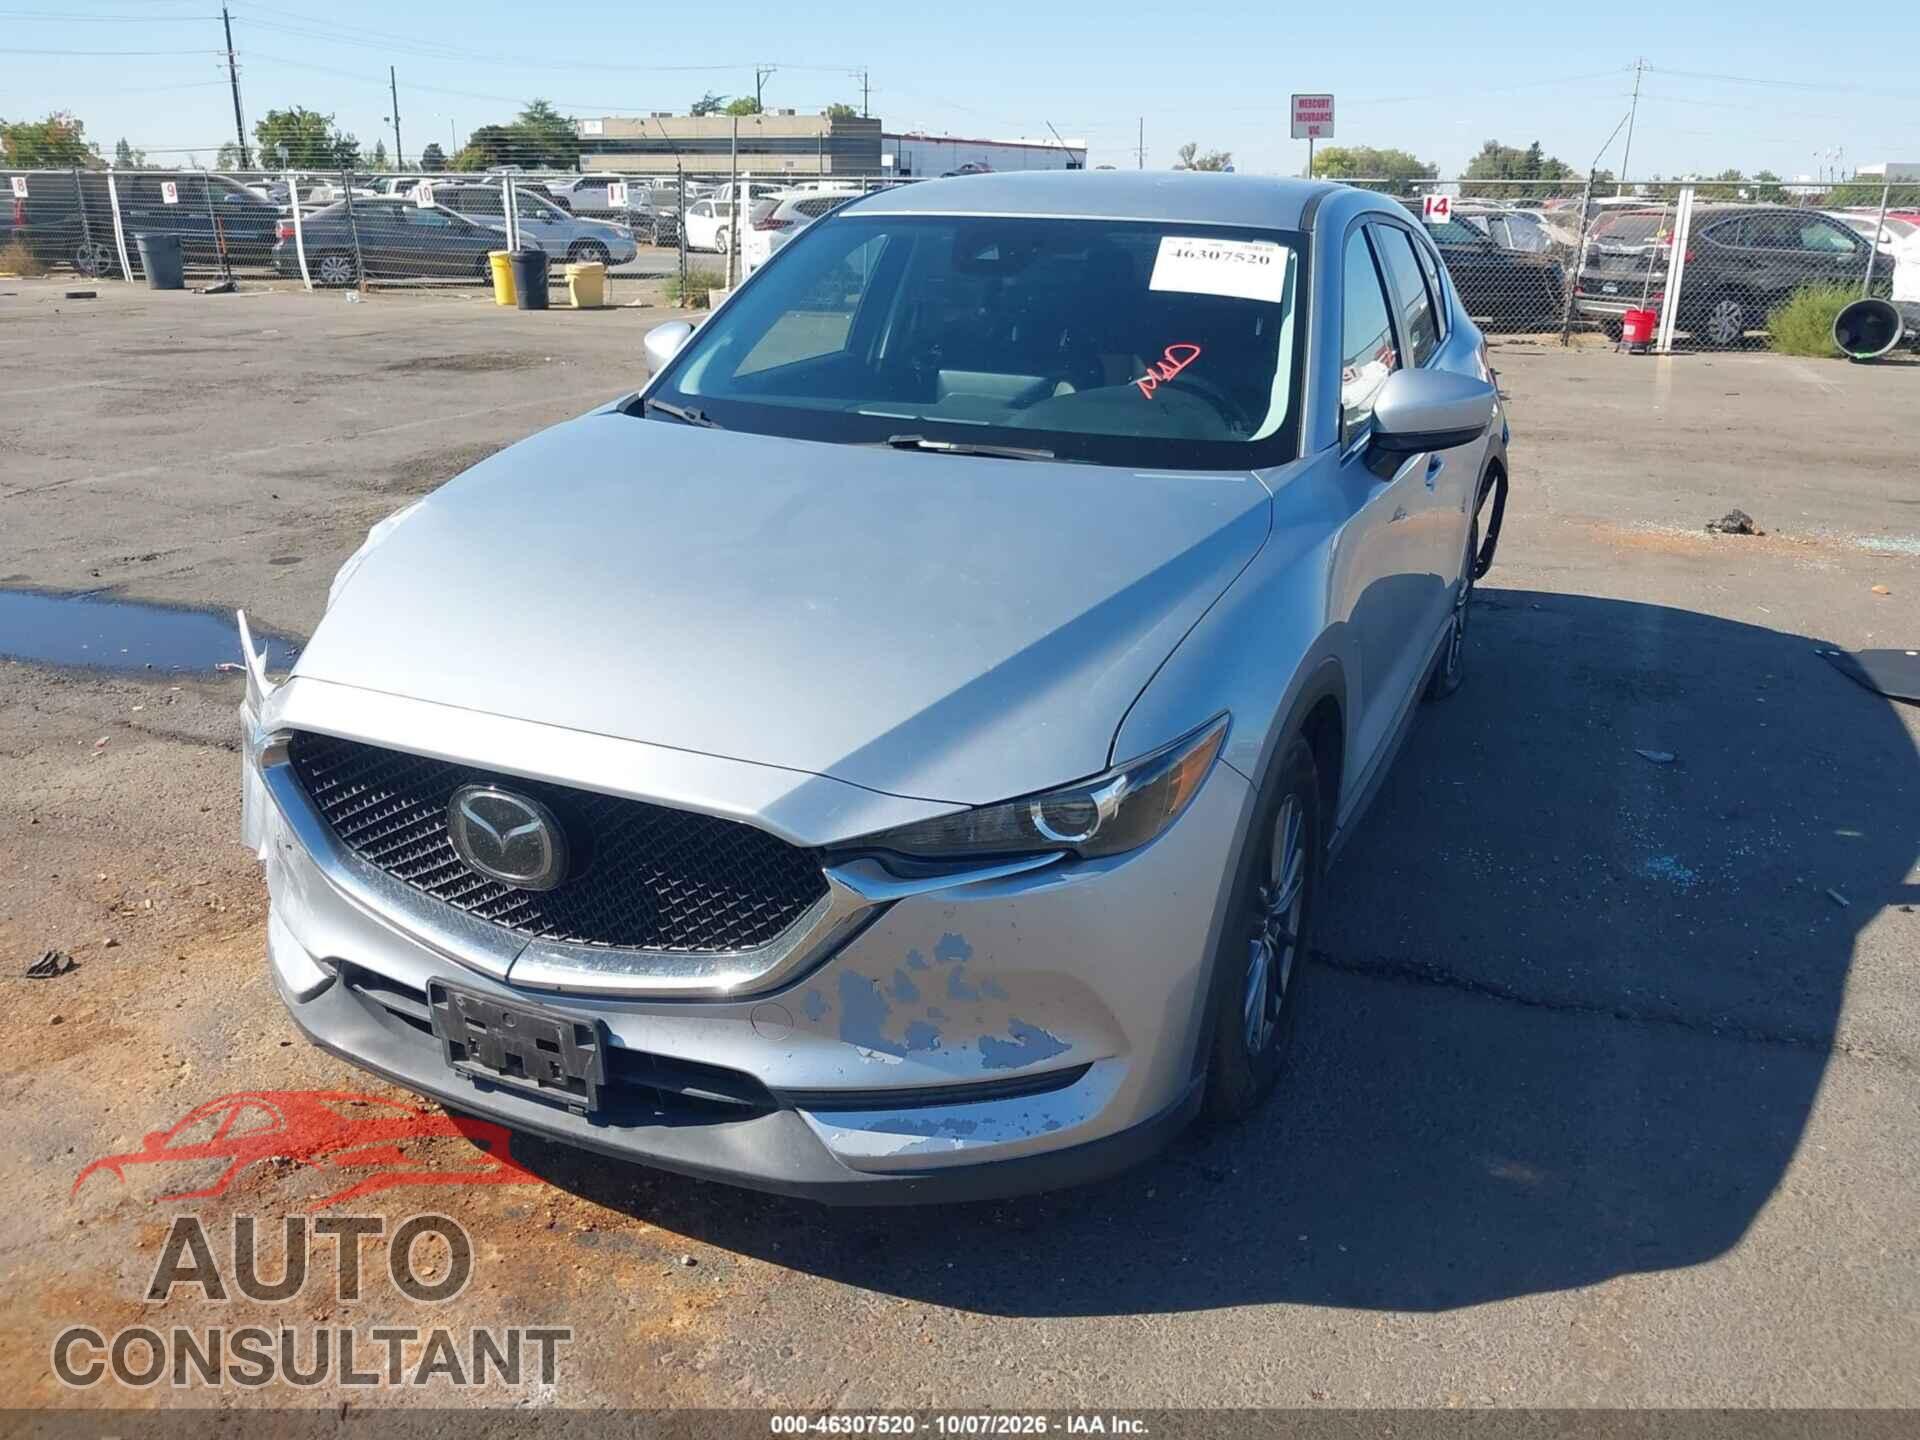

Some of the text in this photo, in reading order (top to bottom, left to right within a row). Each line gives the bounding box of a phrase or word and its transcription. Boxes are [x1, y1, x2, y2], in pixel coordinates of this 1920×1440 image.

[1298, 99, 1330, 108] MERCURY
[1295, 112, 1333, 122] INSURANCE
[16, 178, 25, 192] 8
[167, 183, 176, 197] 9
[418, 186, 432, 201] 10
[610, 185, 624, 200] 11
[1425, 197, 1449, 216] 14
[1168, 248, 1271, 265] 46307520
